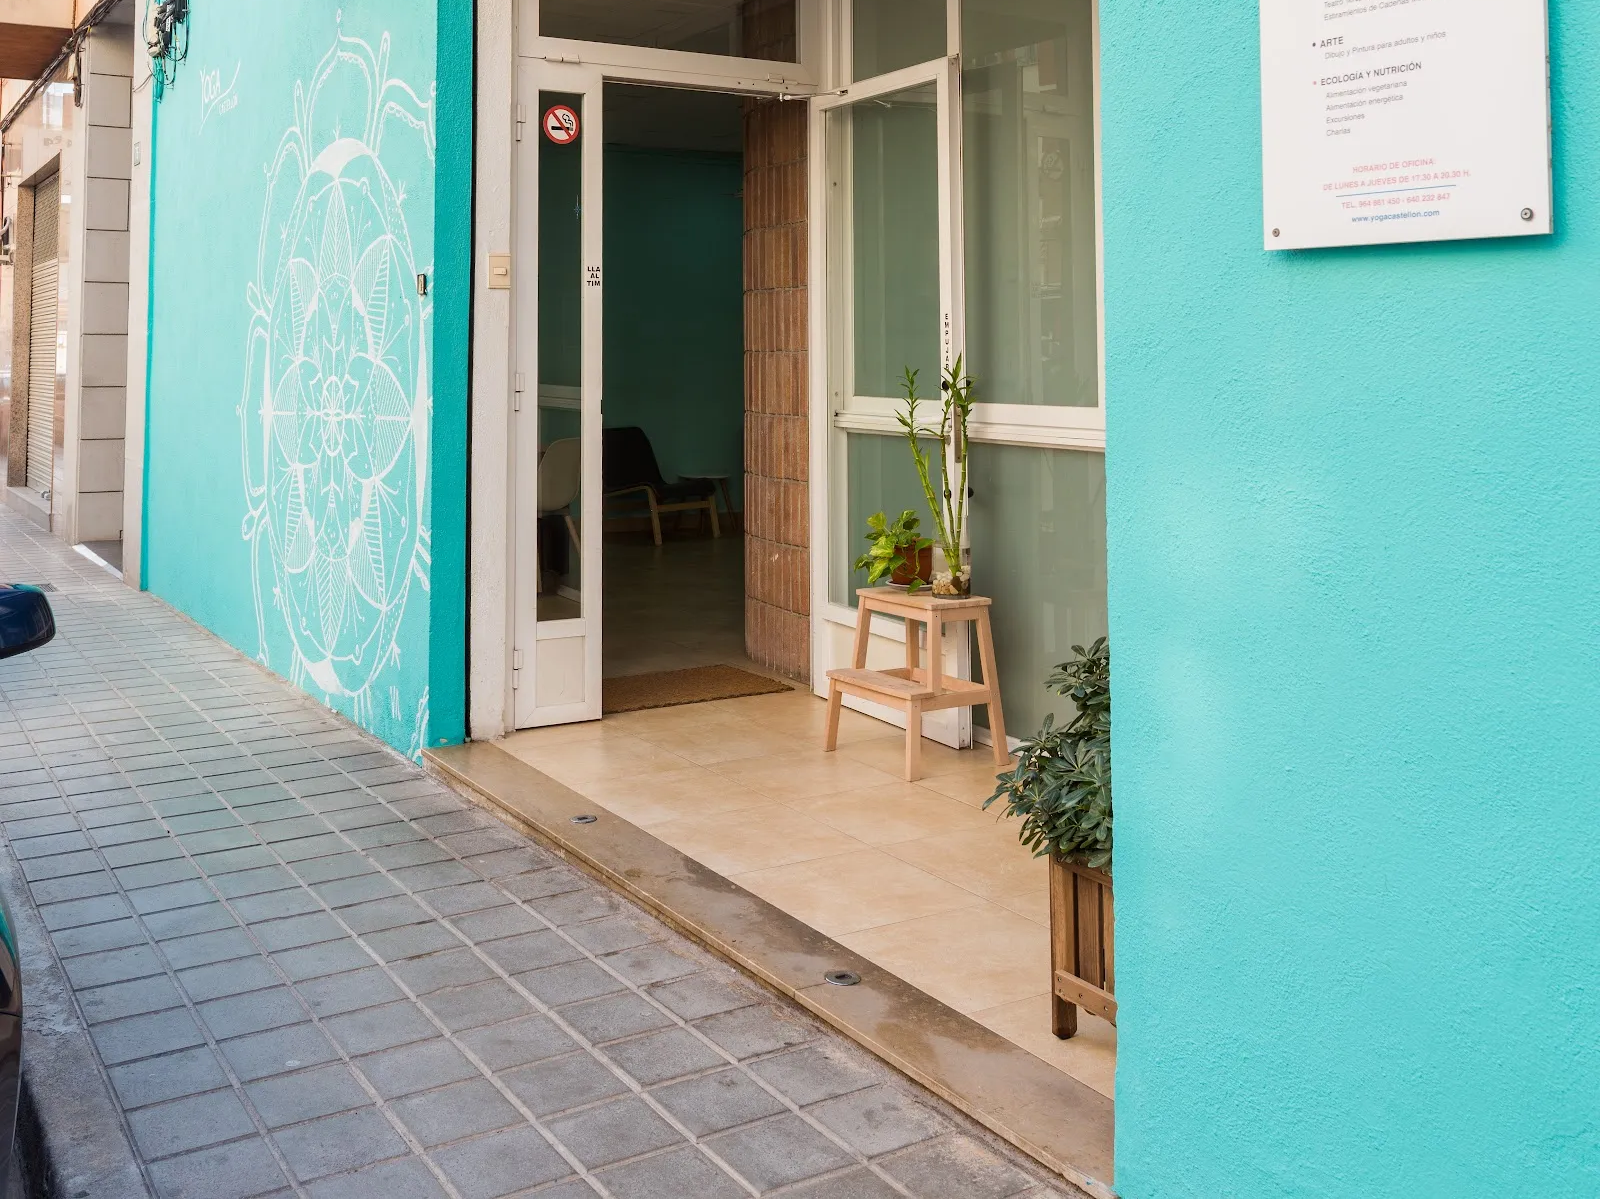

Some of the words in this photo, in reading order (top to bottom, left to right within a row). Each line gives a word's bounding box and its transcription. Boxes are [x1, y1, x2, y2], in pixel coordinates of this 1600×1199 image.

[1323, 6, 1367, 21] Estiramientos
[1368, 3, 1377, 12] de
[1320, 36, 1344, 48] ARTE
[1324, 49, 1345, 60] Dibujo
[1352, 43, 1376, 54] Pintura
[1376, 42, 1393, 51] para
[1394, 36, 1419, 47] adultos
[1426, 30, 1447, 40] niños
[1320, 70, 1364, 86] ECOLOGÍA
[1366, 70, 1372, 78] Y
[1373, 61, 1422, 78] NUTRICIÓN
[199, 64, 221, 120] YOGA
[1326, 86, 1367, 99] Alimentación
[1368, 80, 1408, 93] vegetariana
[1326, 99, 1367, 112] Alimentación
[1326, 113, 1365, 124] Excursiones
[1326, 126, 1351, 137] Charlas
[1352, 163, 1388, 173] HORARIO
[1389, 161, 1400, 170] DE
[1323, 183, 1334, 191] DE
[1335, 180, 1359, 190] LUNES
[1360, 180, 1366, 188] A
[1367, 176, 1397, 187] JUEVES
[1398, 175, 1409, 184] DE
[1352, 209, 1440, 223] www.yogacastellon.com
